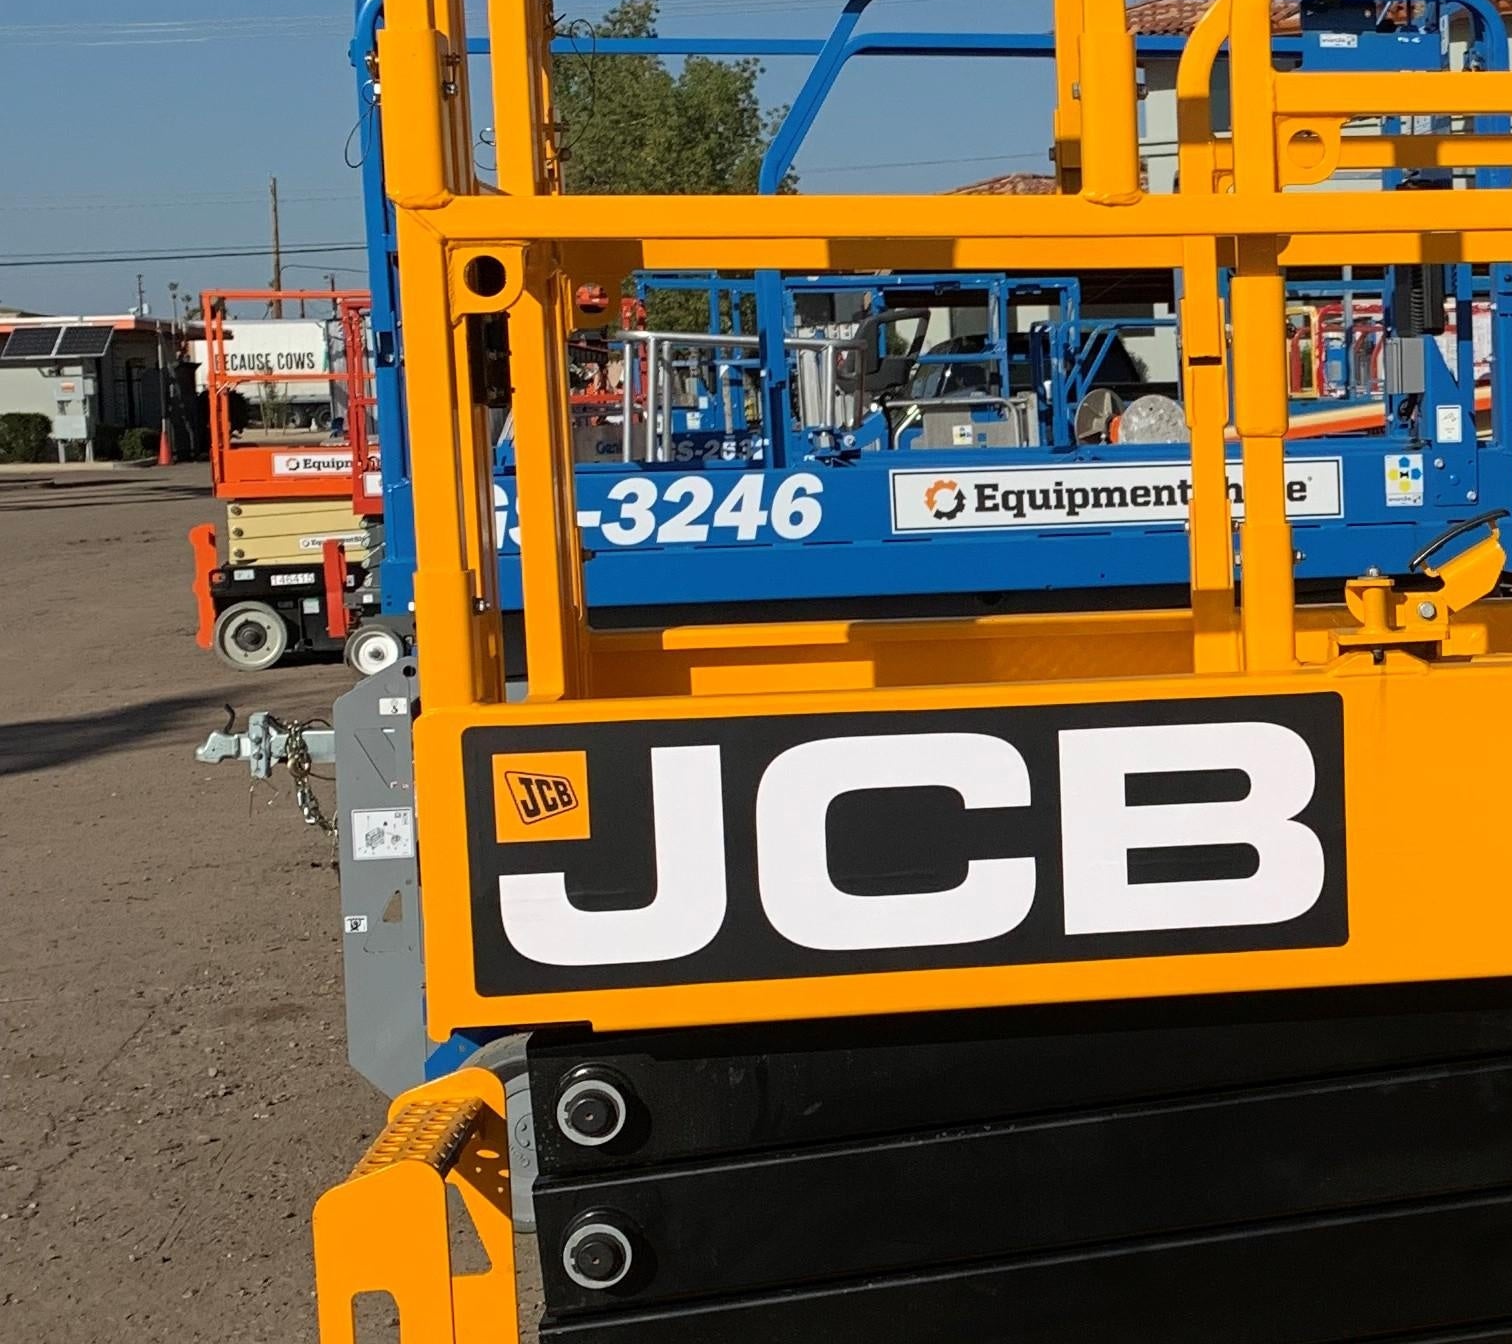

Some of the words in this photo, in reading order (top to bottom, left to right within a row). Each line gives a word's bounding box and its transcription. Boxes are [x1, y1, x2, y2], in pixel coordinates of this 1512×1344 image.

[278, 352, 315, 369] COWS
[518, 776, 573, 818] JCB
[498, 721, 1325, 966] JCB
